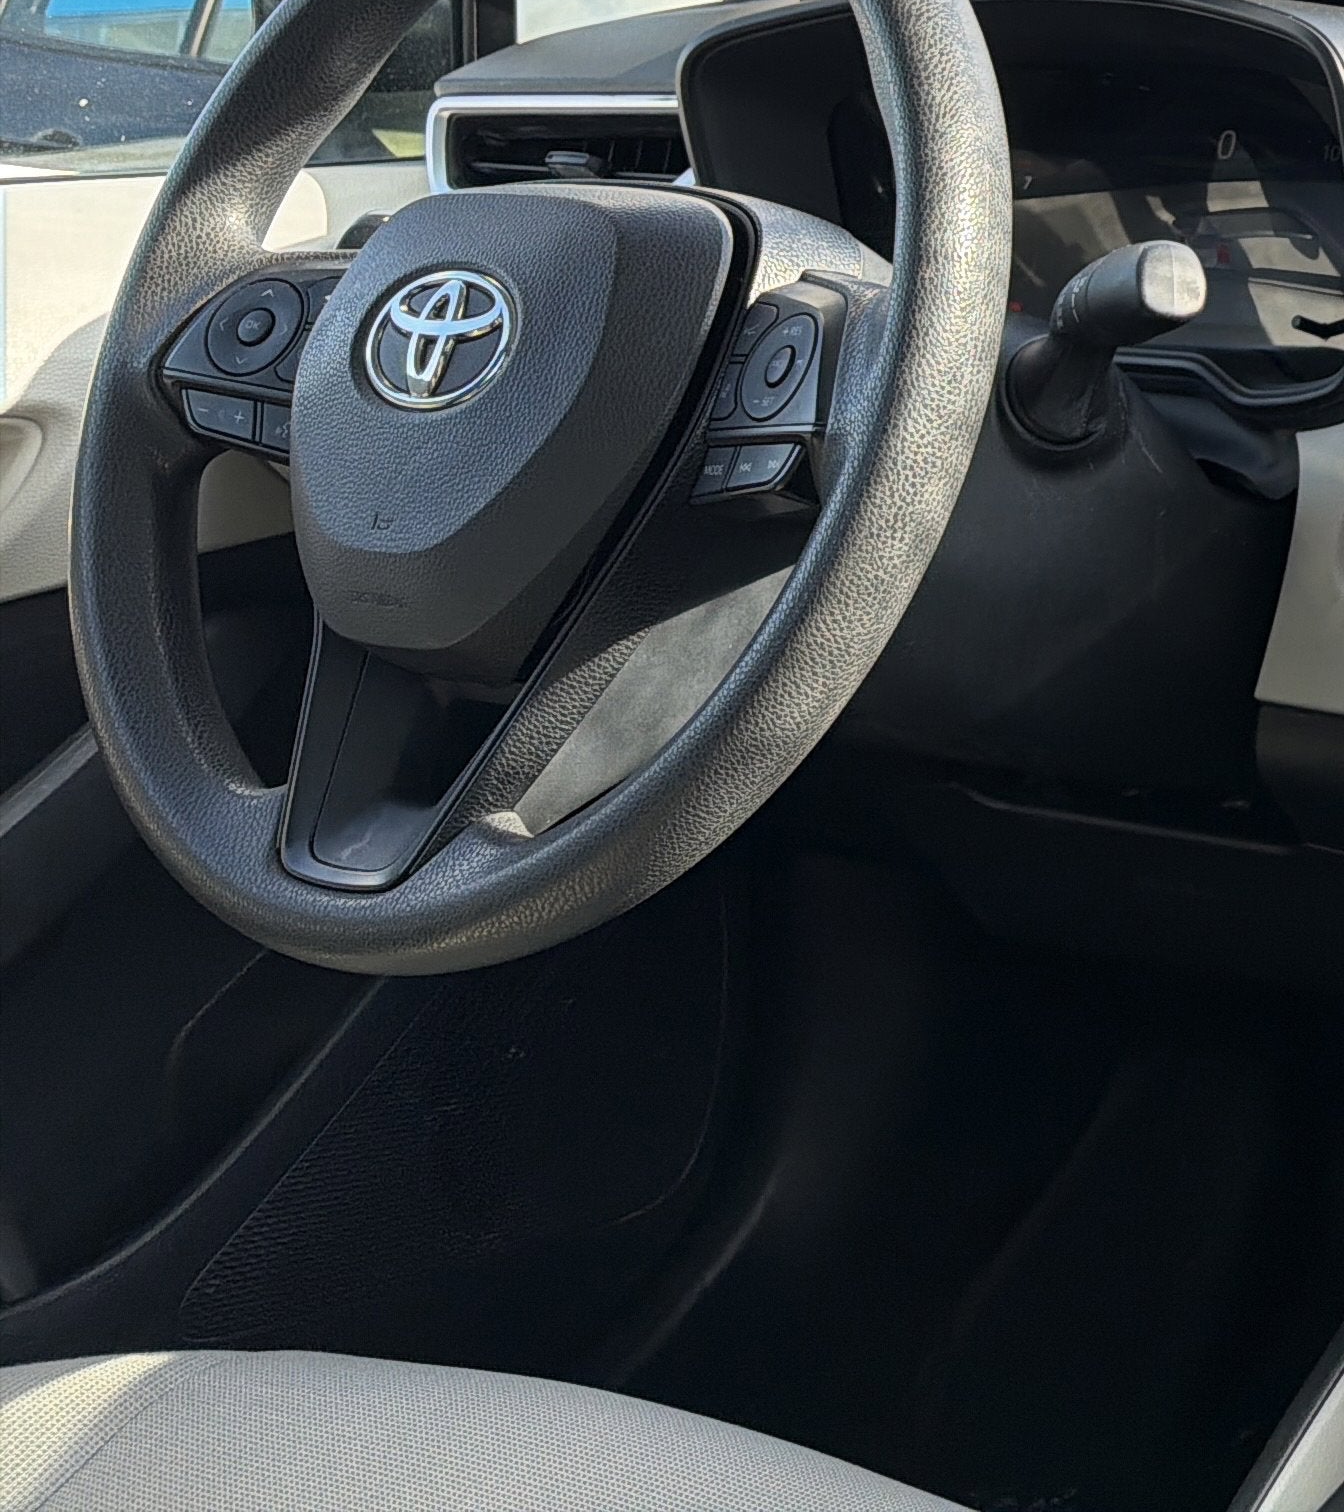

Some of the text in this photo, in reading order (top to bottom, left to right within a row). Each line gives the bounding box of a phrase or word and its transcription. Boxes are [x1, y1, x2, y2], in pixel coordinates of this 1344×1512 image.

[1217, 129, 1238, 160] 0
[244, 319, 262, 331] OK
[703, 463, 725, 476] MODE
